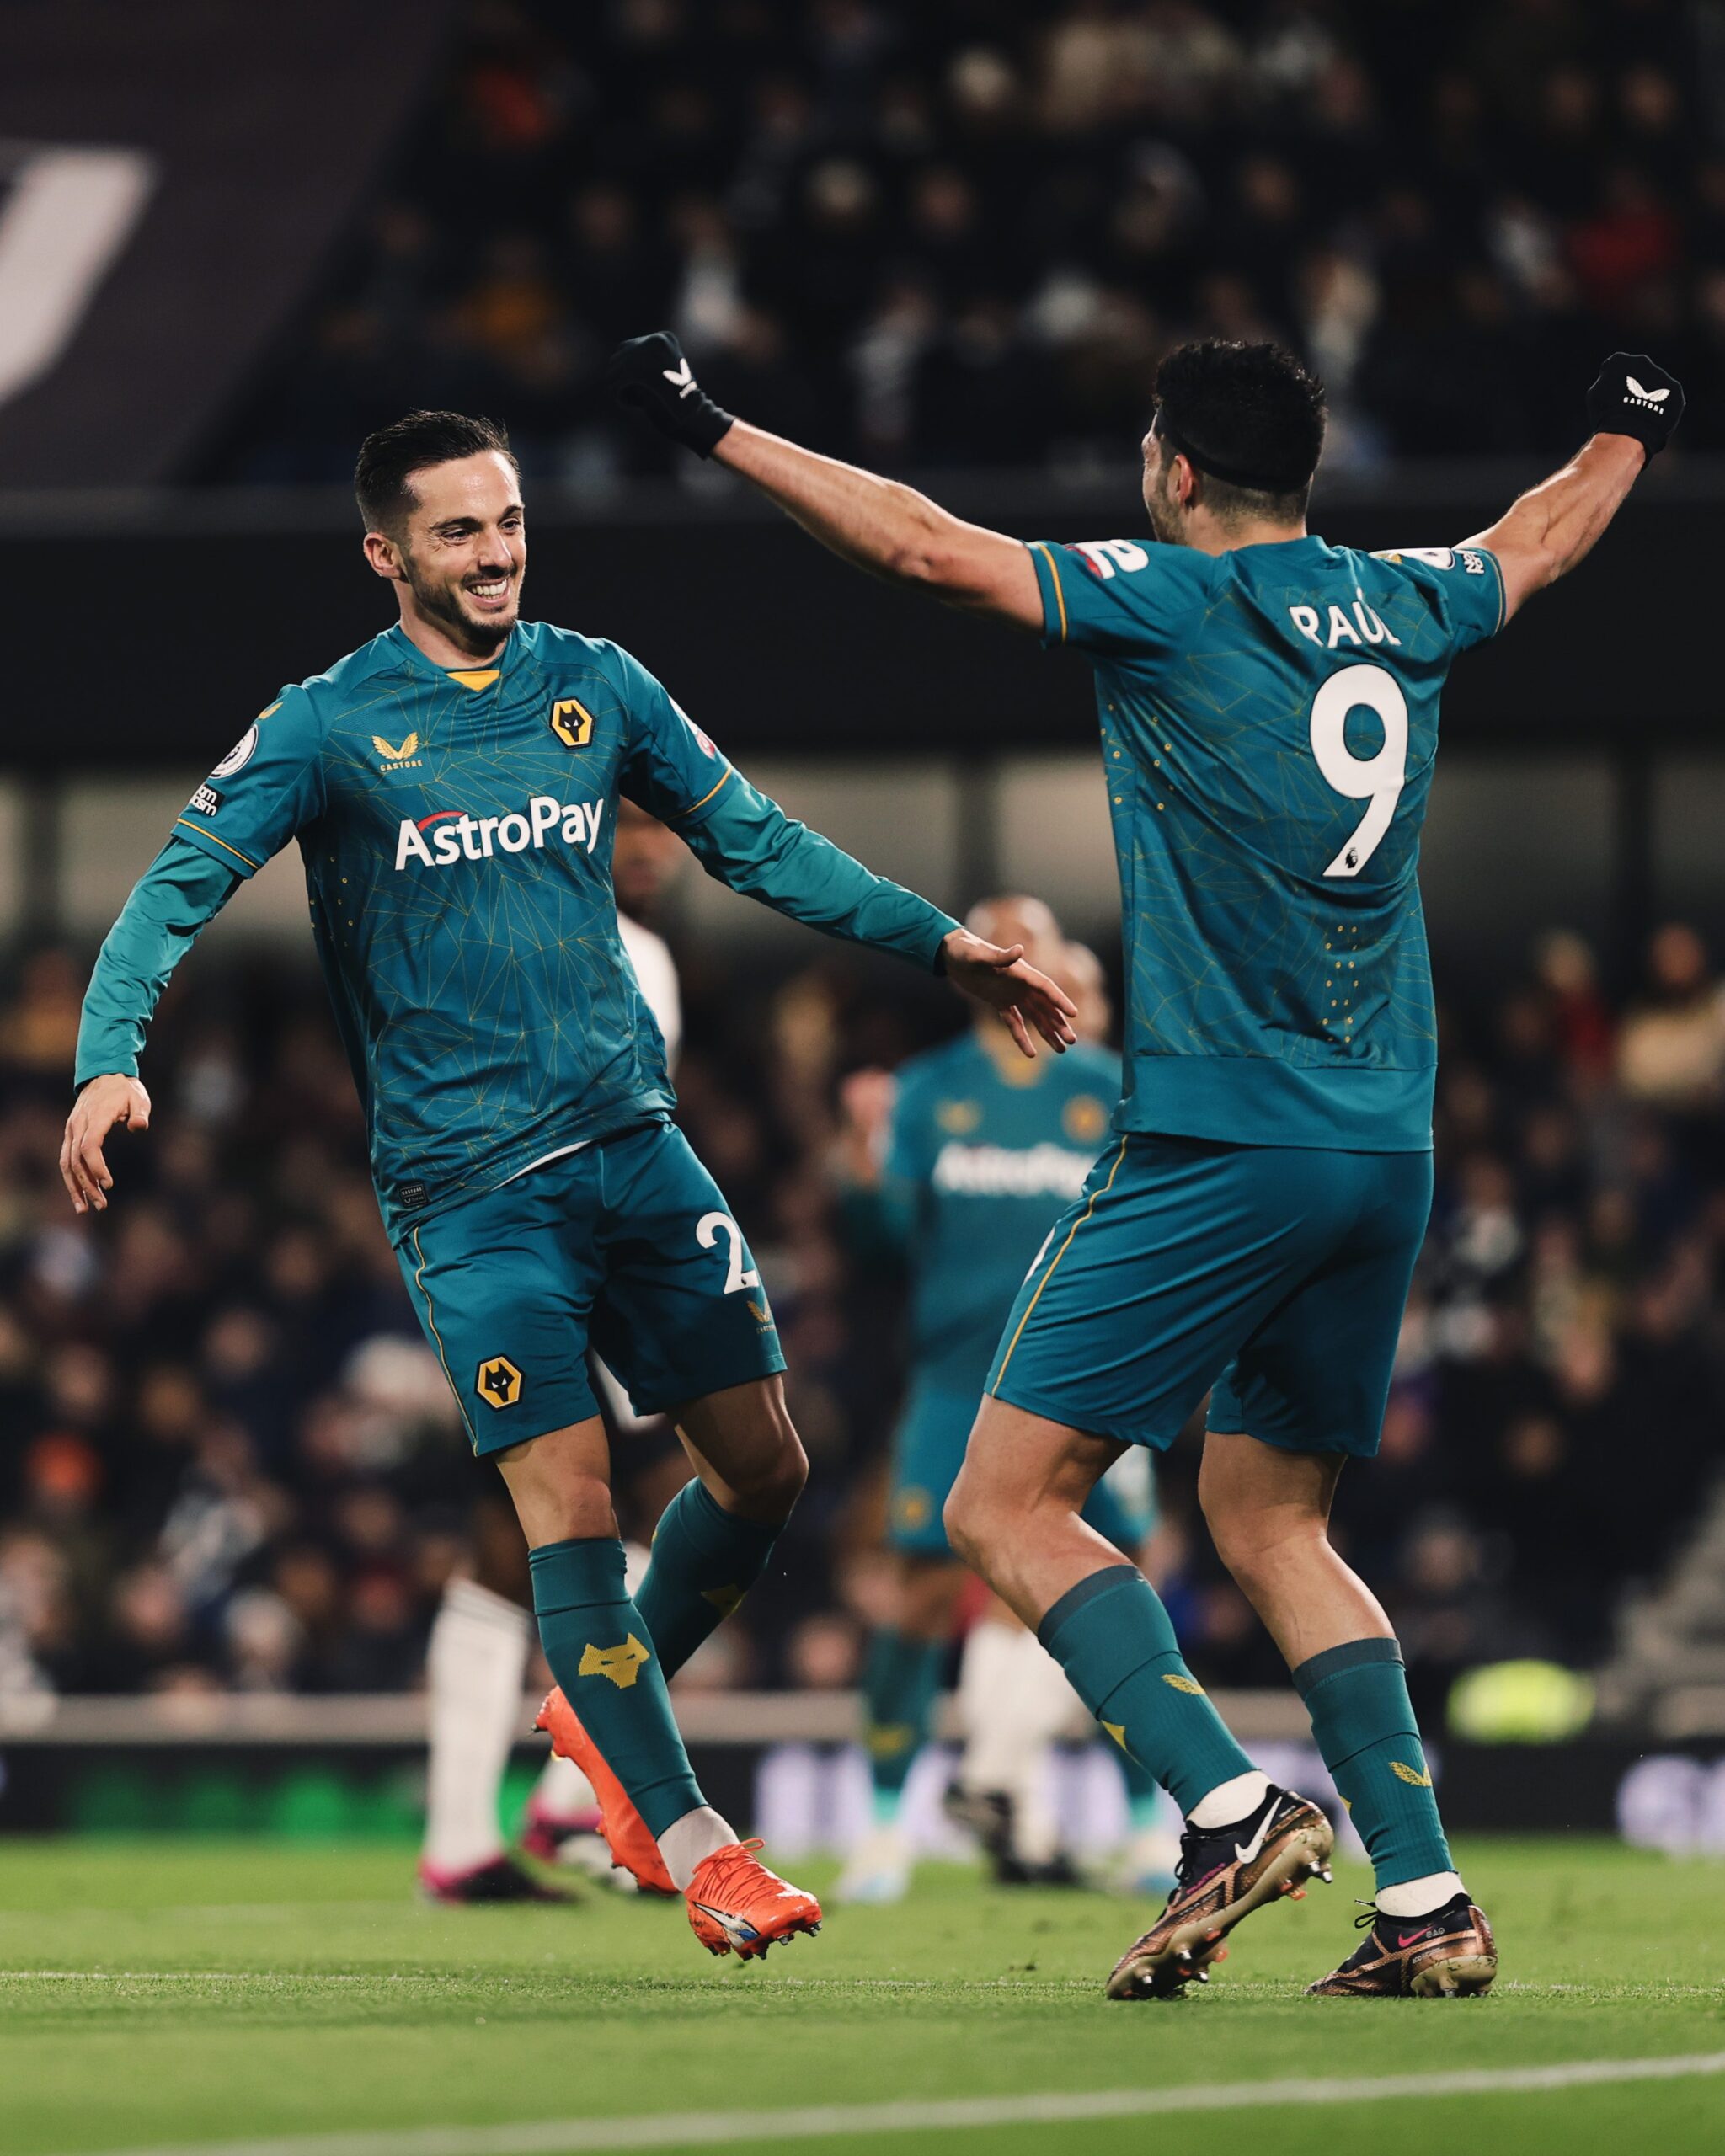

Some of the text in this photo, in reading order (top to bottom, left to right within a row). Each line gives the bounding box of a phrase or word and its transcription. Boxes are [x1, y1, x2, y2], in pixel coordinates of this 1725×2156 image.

[380, 760, 423, 771] CASTORE
[1309, 664, 1409, 877] 9
[394, 795, 604, 871] AstroPay
[696, 1211, 760, 1294] 2
